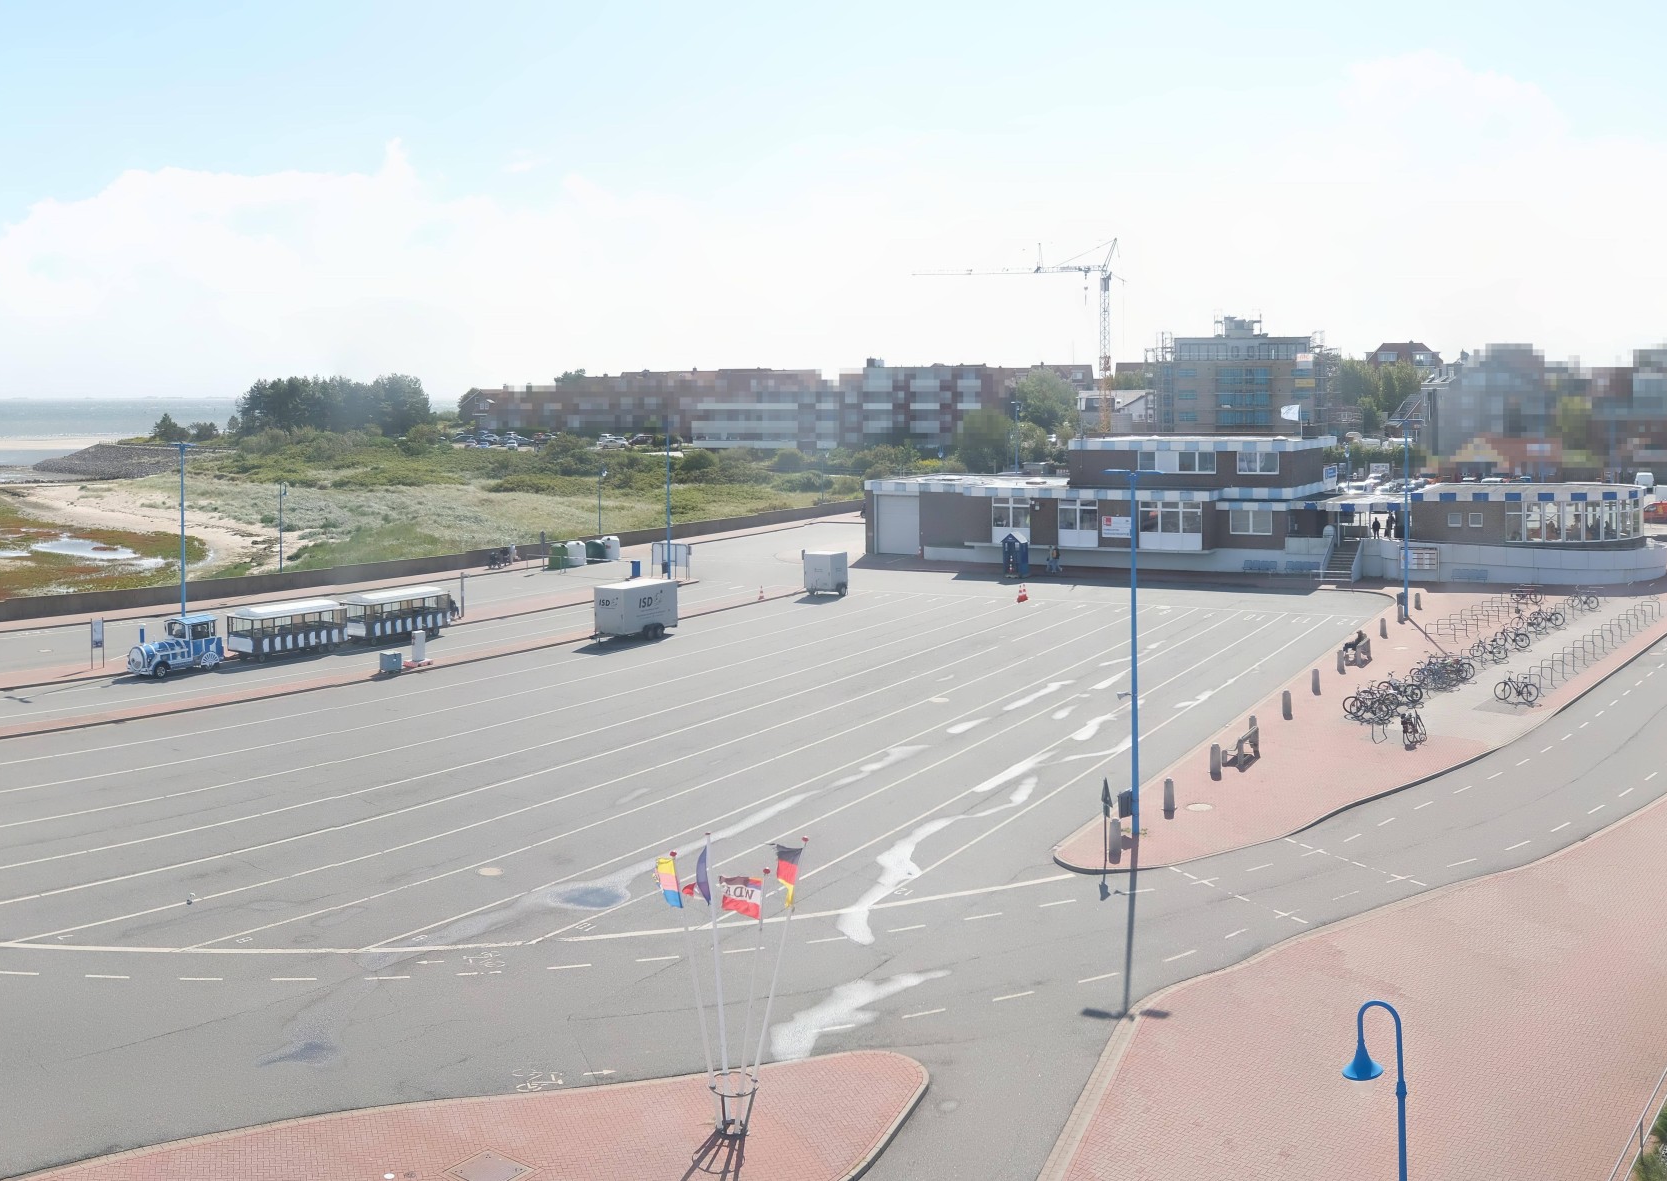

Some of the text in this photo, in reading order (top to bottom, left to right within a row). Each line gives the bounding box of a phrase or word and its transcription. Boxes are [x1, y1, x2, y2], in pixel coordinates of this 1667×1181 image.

[598, 598, 611, 608] ISD
[638, 596, 654, 609] ISD
[894, 887, 914, 896] 12
